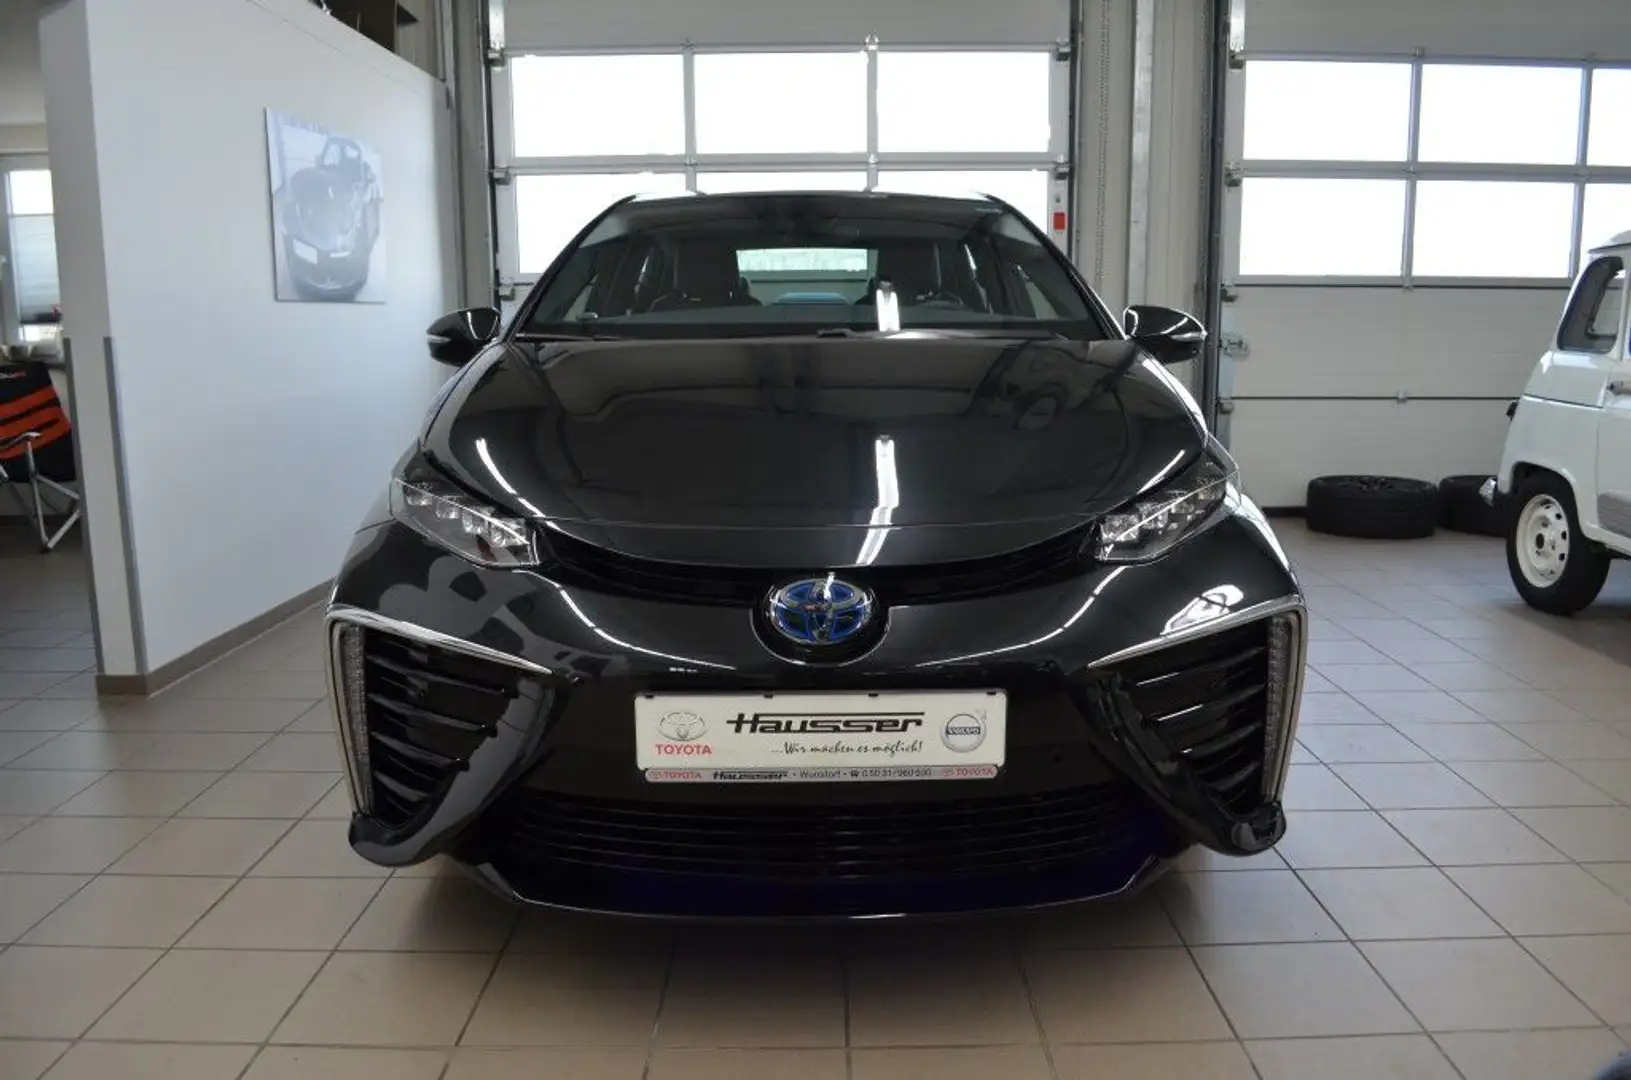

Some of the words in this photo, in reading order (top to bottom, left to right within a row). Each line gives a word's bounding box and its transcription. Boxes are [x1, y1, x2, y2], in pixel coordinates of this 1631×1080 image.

[726, 711, 925, 734] Hausser
[655, 743, 713, 755] TOYOTA
[809, 740, 853, 754] machen
[857, 744, 869, 754] es
[872, 739, 924, 758] möglich!
